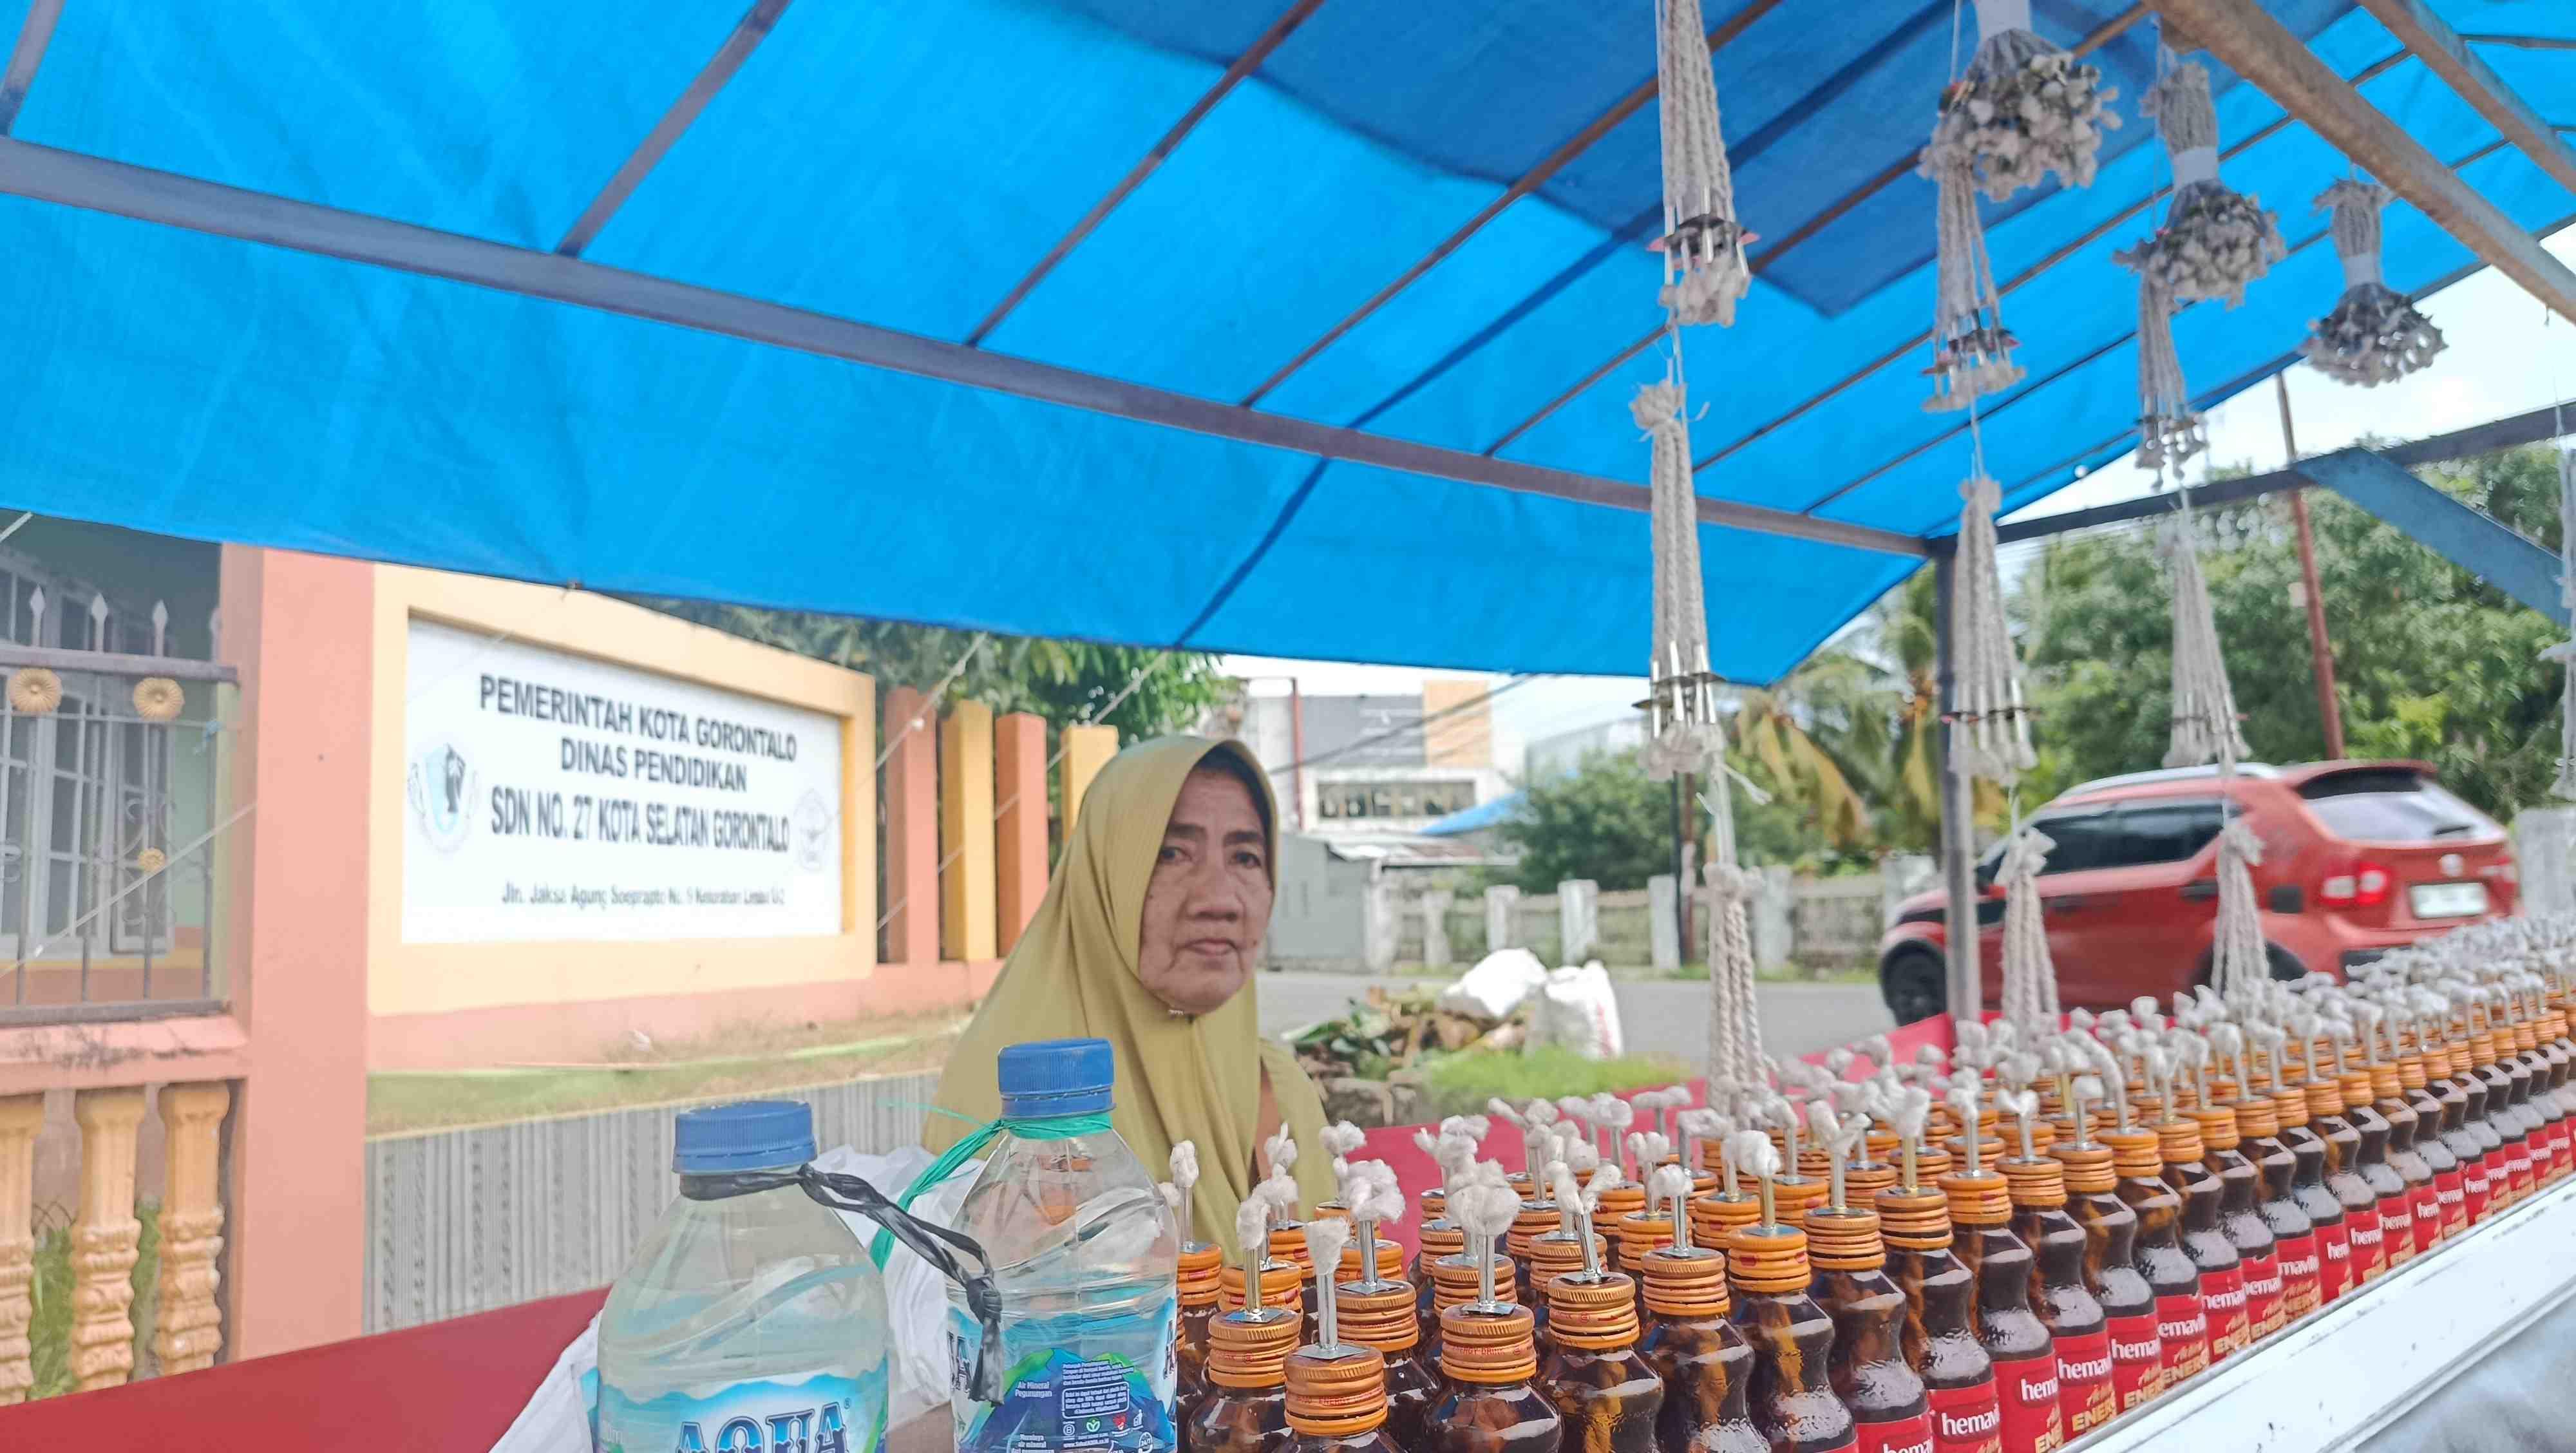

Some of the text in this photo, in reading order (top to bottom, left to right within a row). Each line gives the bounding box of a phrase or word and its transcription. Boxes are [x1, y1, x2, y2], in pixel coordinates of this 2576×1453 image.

[480, 672, 797, 763] PEMERINTAH KOTA GORONTALO
[561, 737, 747, 792] DINAS PENDIDIKAN
[491, 784, 790, 853] SDN NO. 27 KOTA SELATAN GORONTALO
[571, 883, 607, 911] Agung
[1027, 1381, 1050, 1389] Mineral
